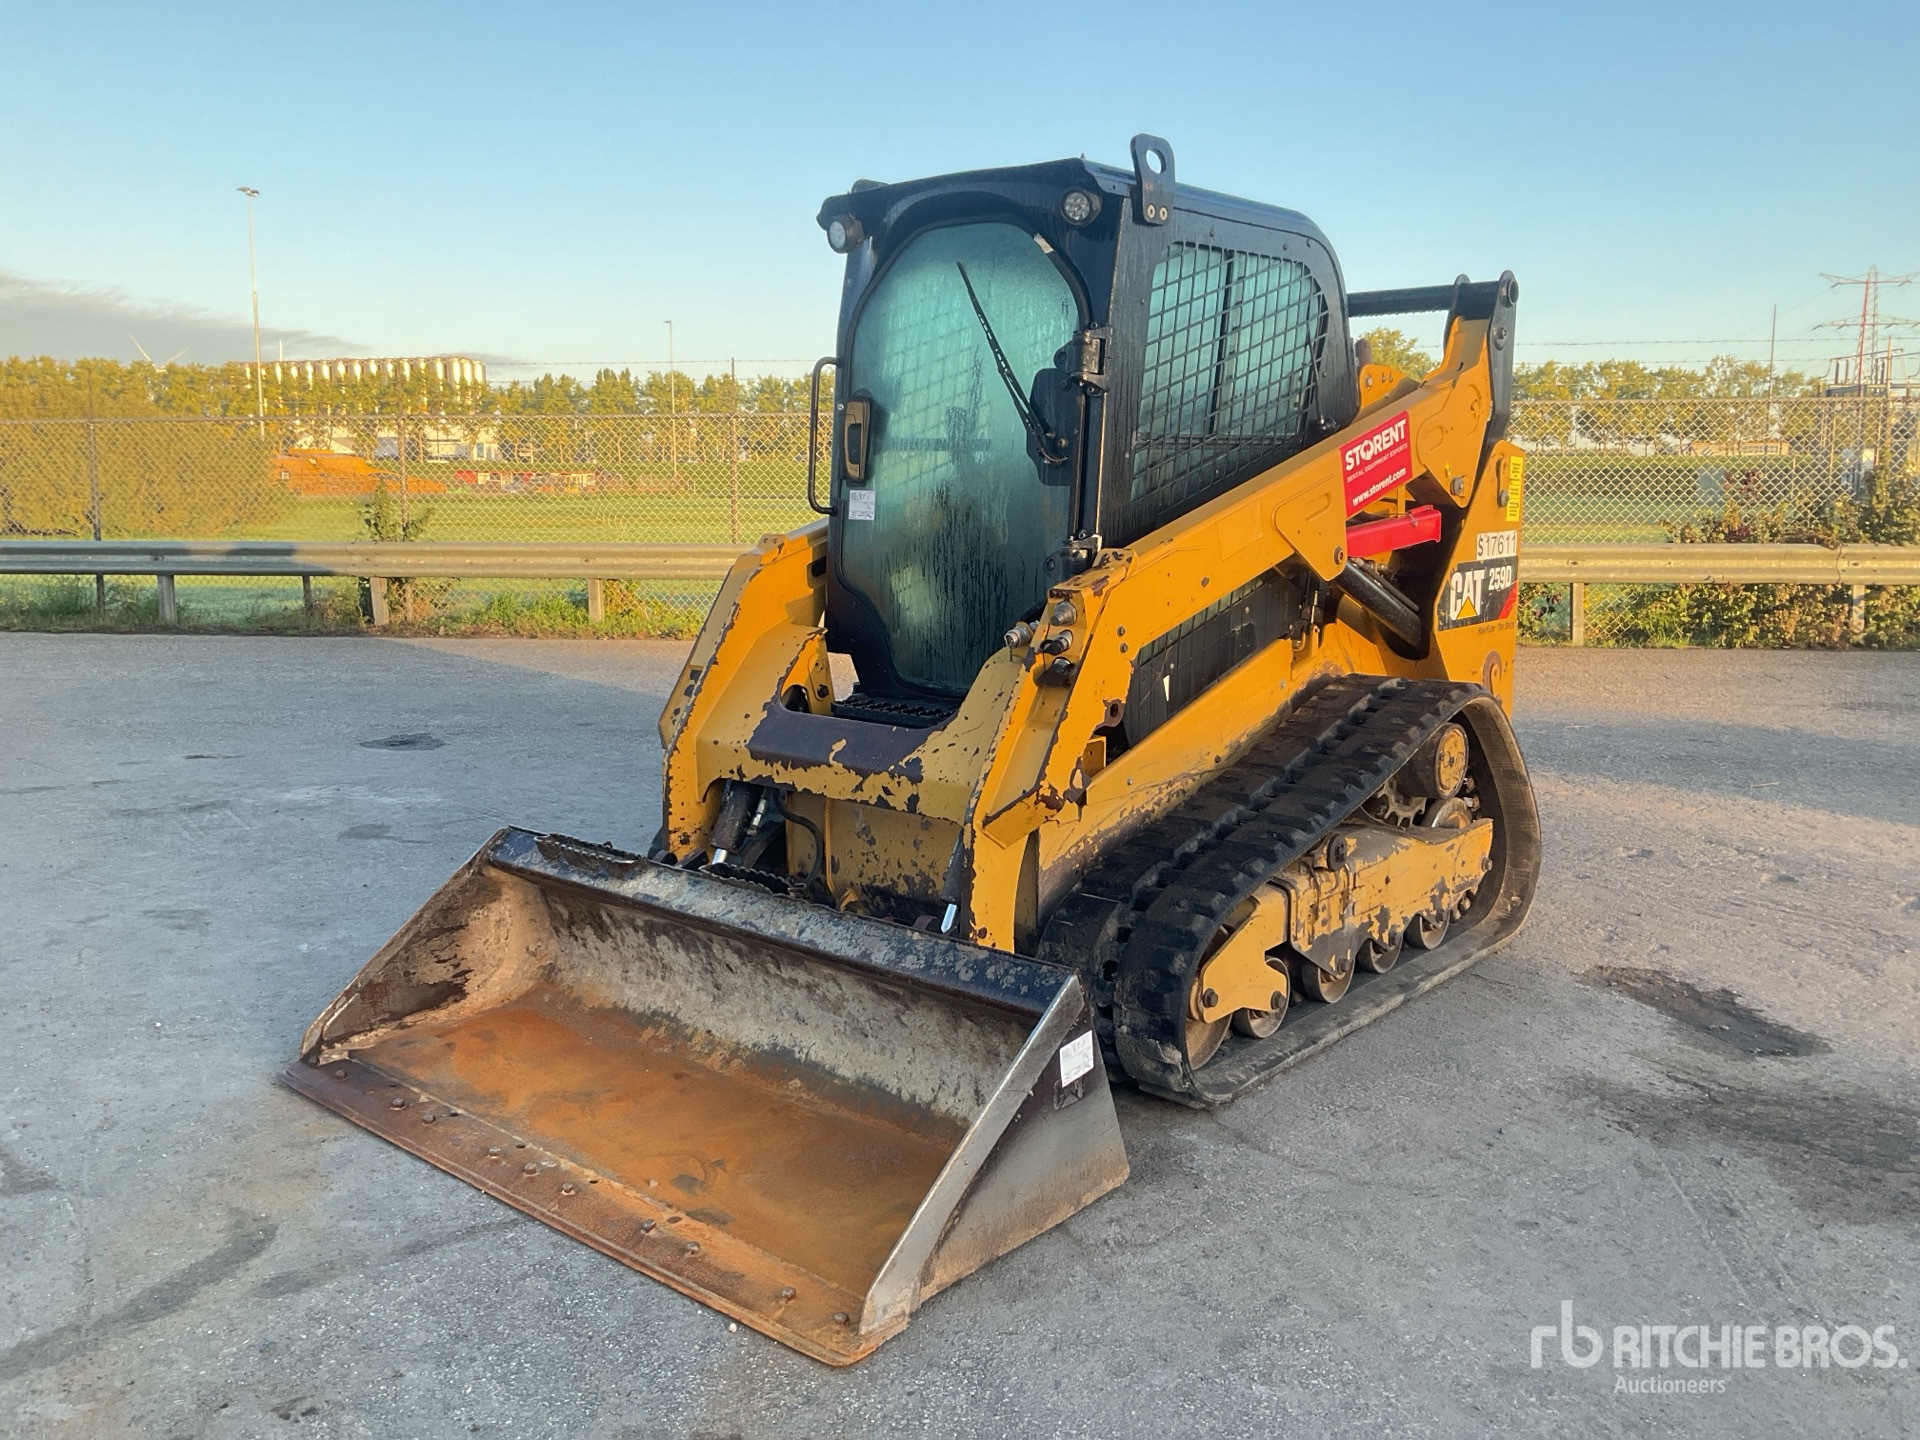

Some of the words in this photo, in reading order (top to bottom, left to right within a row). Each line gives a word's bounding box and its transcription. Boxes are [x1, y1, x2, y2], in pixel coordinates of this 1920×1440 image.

[1345, 419, 1407, 471] STORENT
[1352, 467, 1407, 507] www.storent.com
[1477, 532, 1517, 557] S17611
[1449, 569, 1486, 621] CAT
[1488, 565, 1512, 591] 259D
